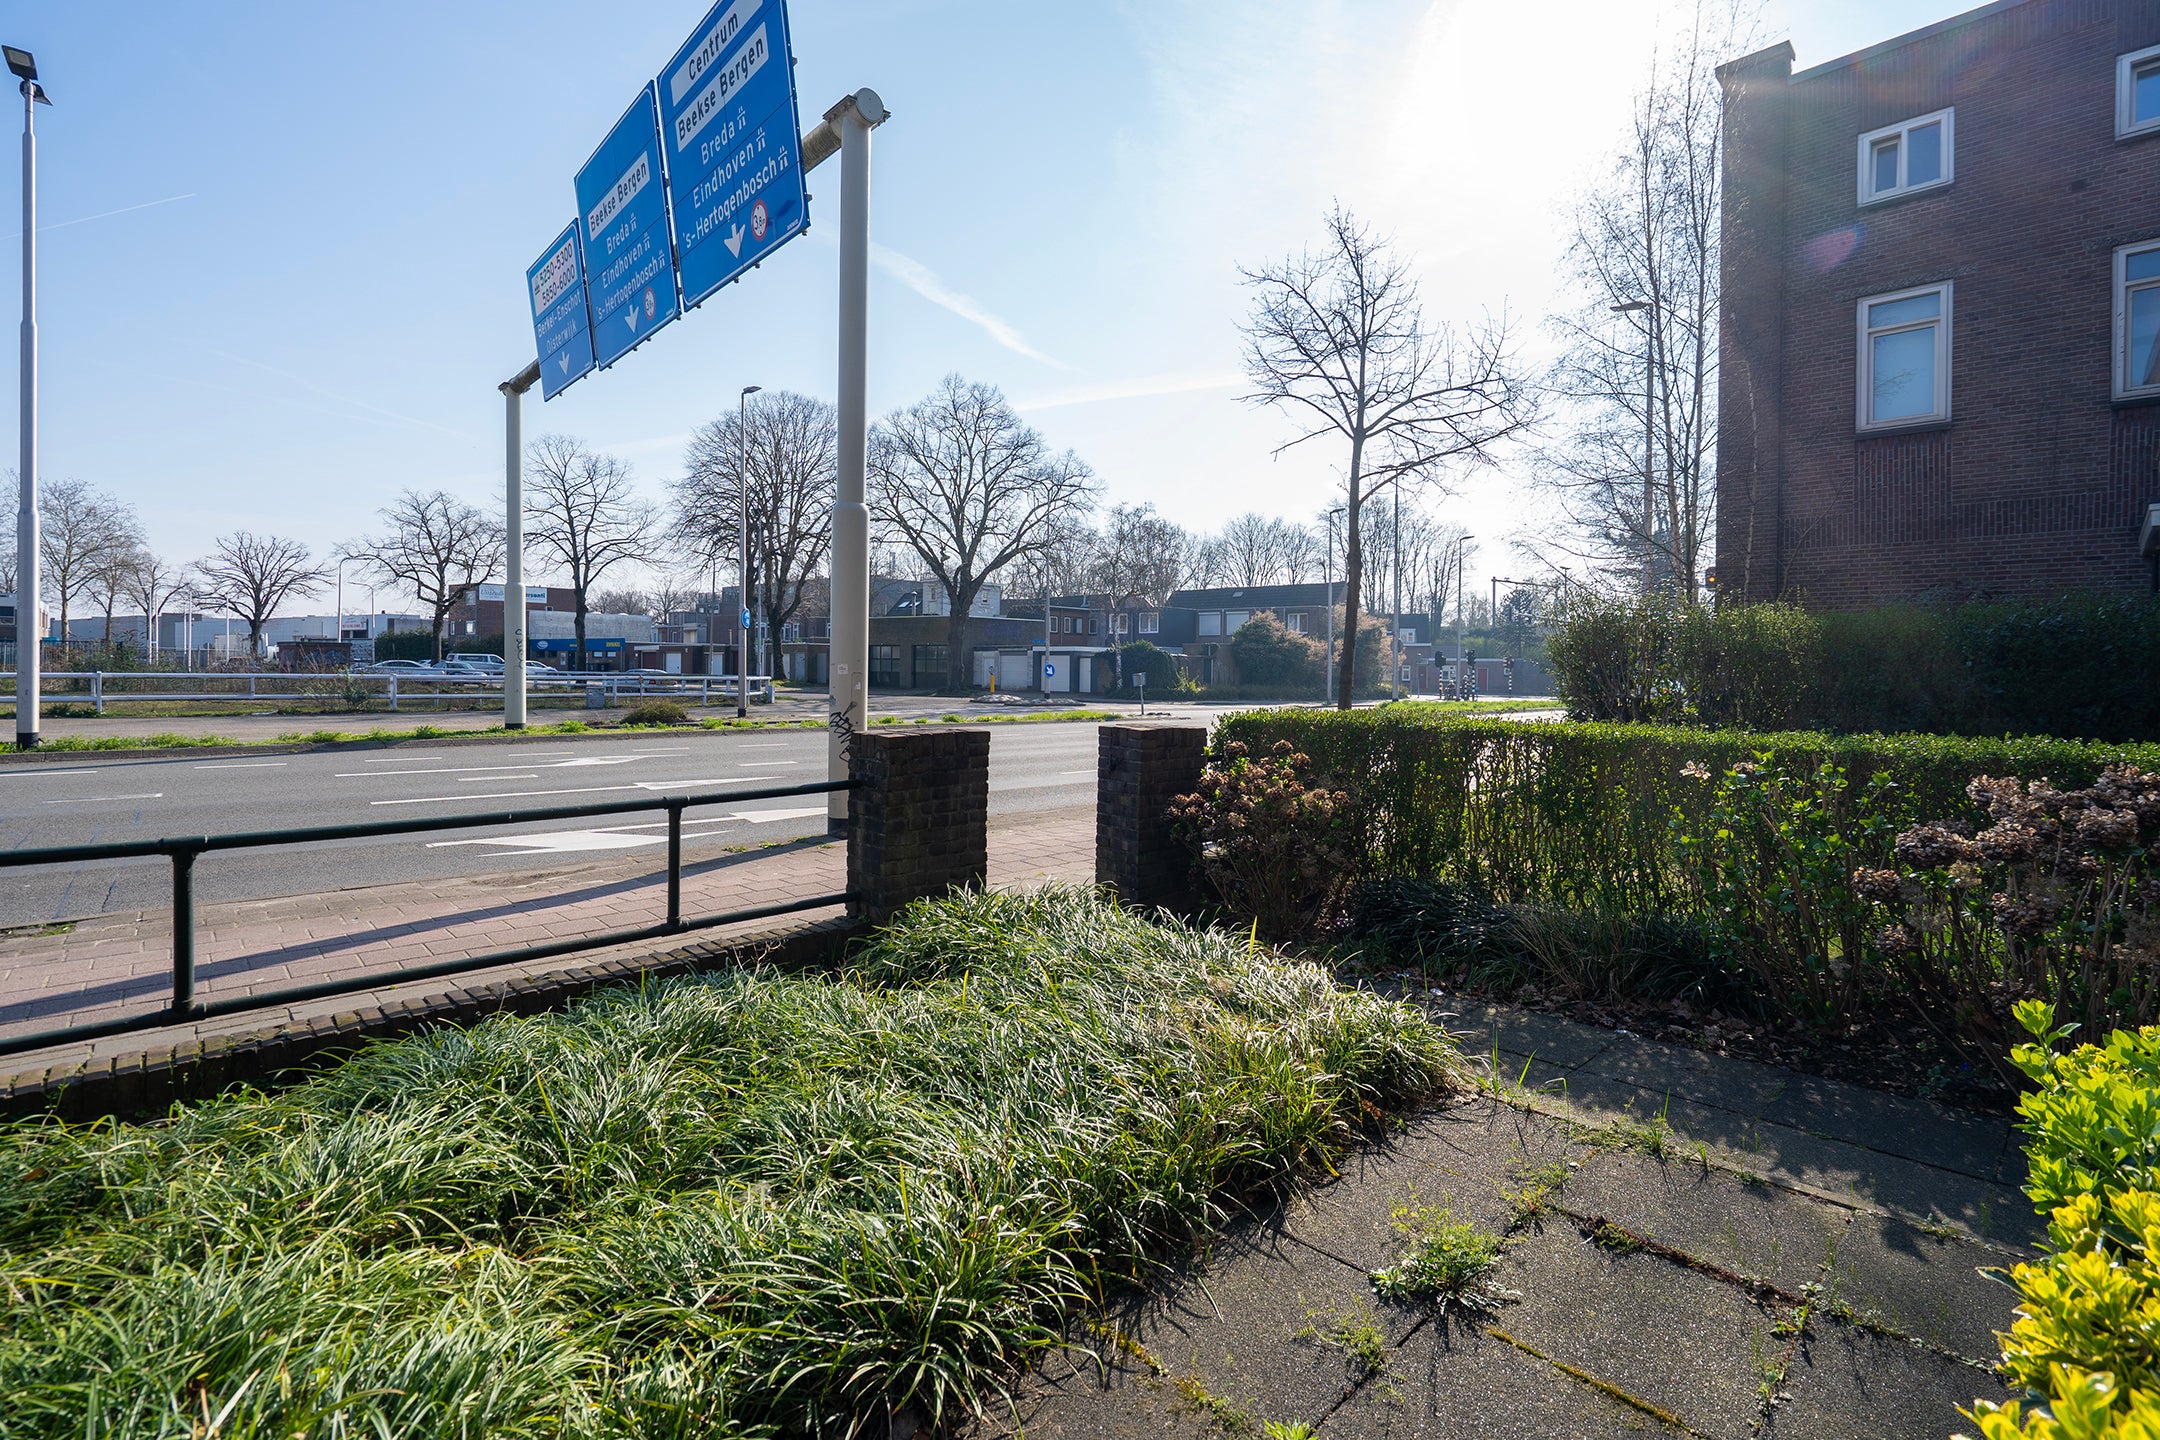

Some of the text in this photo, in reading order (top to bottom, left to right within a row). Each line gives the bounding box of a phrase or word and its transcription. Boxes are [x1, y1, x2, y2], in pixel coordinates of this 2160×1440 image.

[688, 13, 739, 80] Centrum
[678, 38, 764, 141] Beekse Bergen
[701, 121, 735, 165] Breda
[590, 162, 647, 233] Beekse Bergen
[682, 157, 777, 248] 's-Hertogenbosch
[693, 143, 754, 209] Eindhoven
[539, 243, 573, 288] 5250-5300
[602, 242, 643, 289] Eindhoven
[606, 221, 630, 255] Breda
[537, 291, 581, 338] Berkel-Enschot
[596, 256, 659, 320] 's-Hertogenbosch
[546, 319, 577, 353] Oisterwijk
